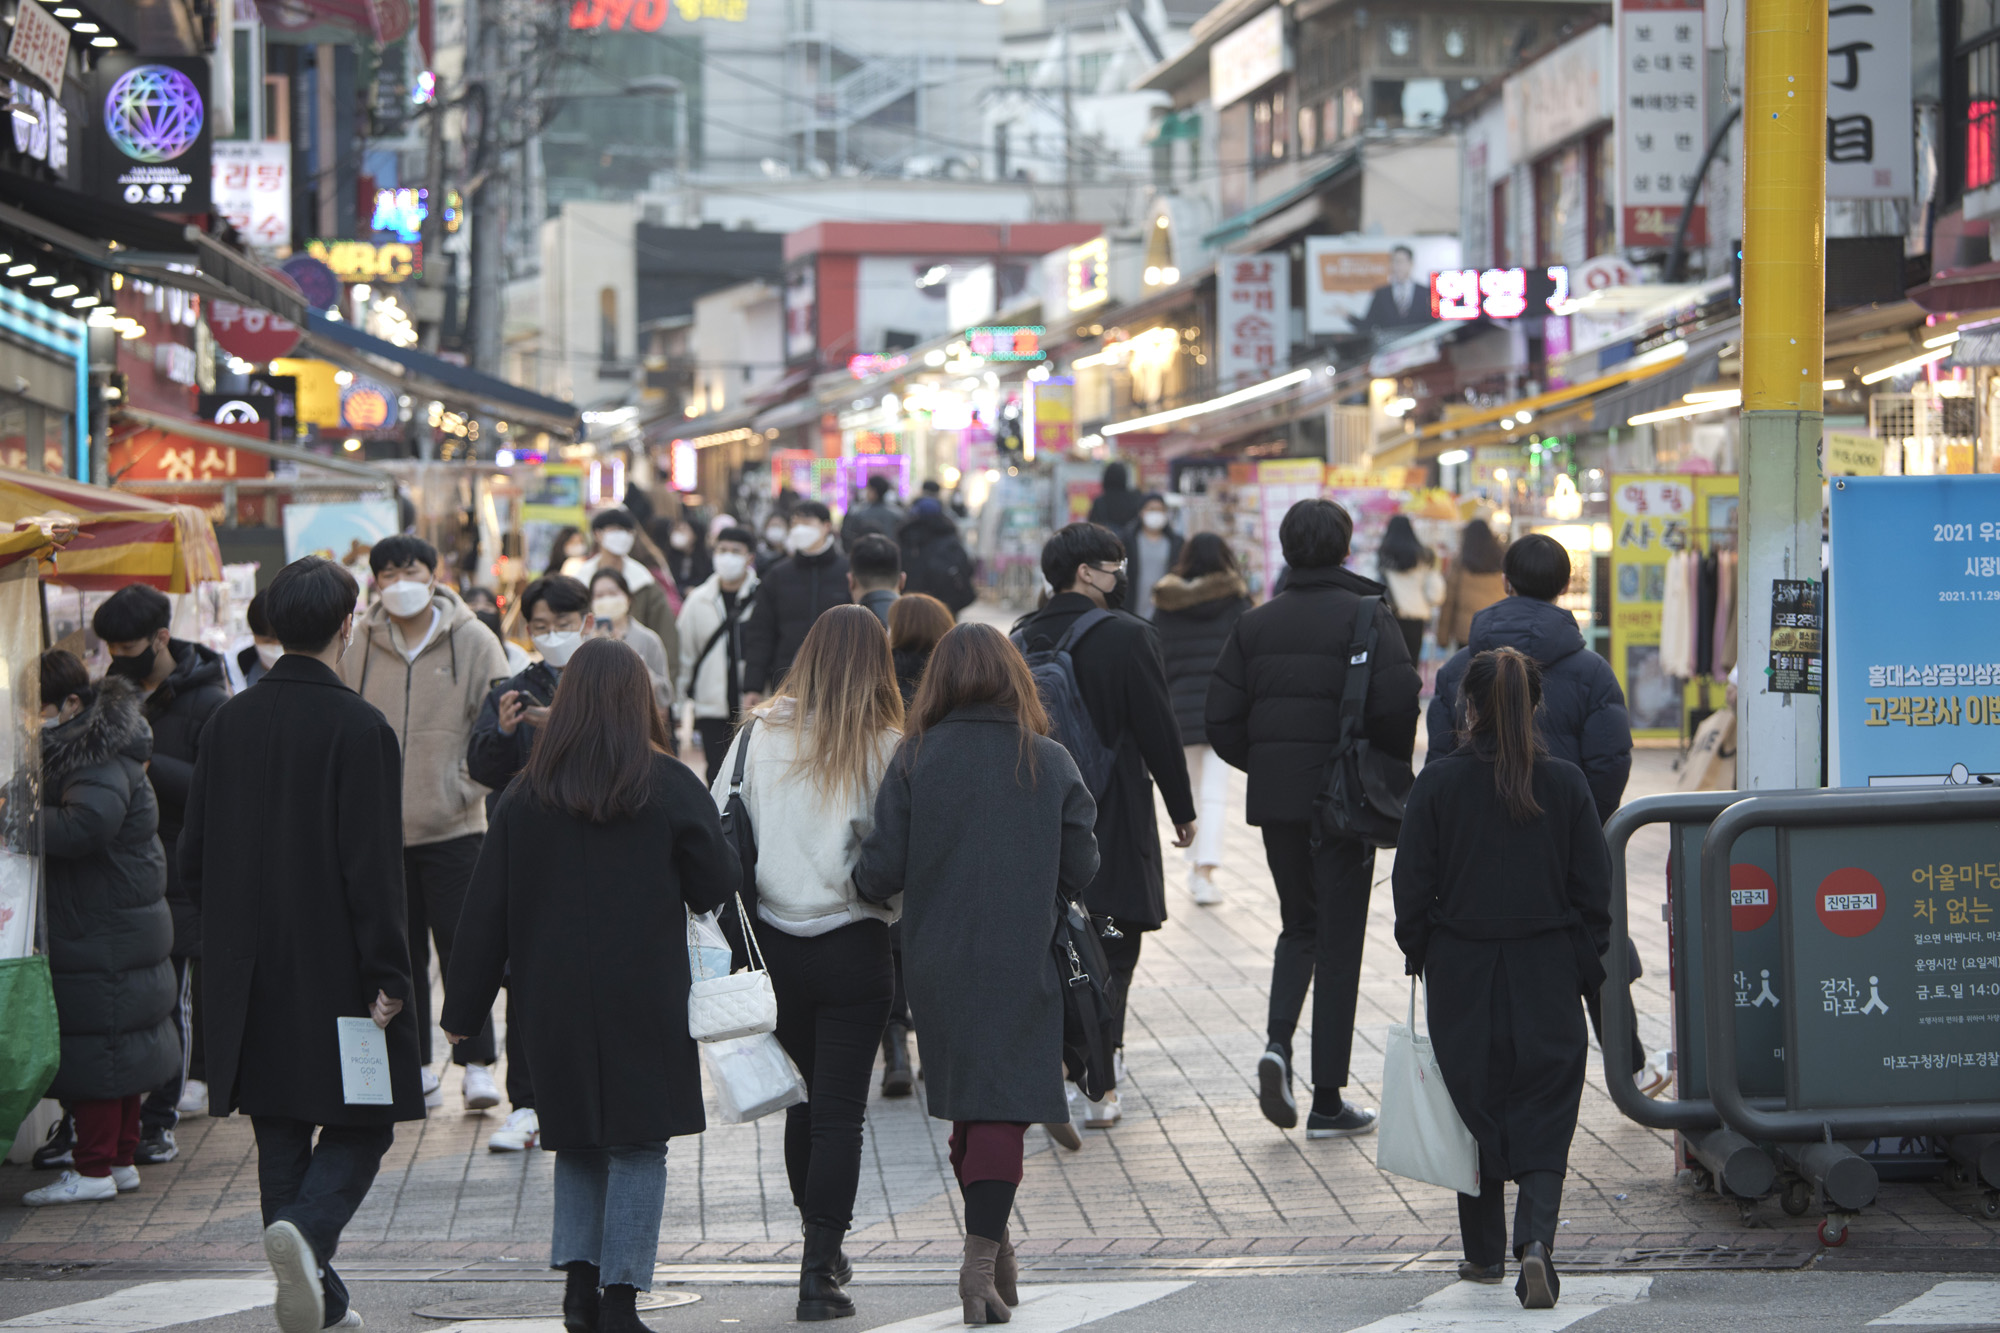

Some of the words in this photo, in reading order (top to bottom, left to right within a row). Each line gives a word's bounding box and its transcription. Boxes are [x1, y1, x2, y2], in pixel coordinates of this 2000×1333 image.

[1933, 523, 1973, 542] 2021
[1863, 695, 1962, 727] 고객감사
[1826, 896, 1874, 909] 진입금지
[1913, 897, 1938, 925] 차
[1946, 896, 1993, 925] 없는
[1914, 932, 1941, 945] 걸으면
[1944, 931, 1984, 944] 바뀝니다.
[1914, 957, 1958, 972] 운영시간
[1961, 956, 2000, 971] (요일제)
[1820, 977, 1861, 999] 걷자,
[1915, 983, 1964, 1001] 금.토.일
[1823, 998, 1860, 1017] 마포
[350, 1056, 383, 1065] PRODIGAL
[360, 1066, 377, 1075] GOD
